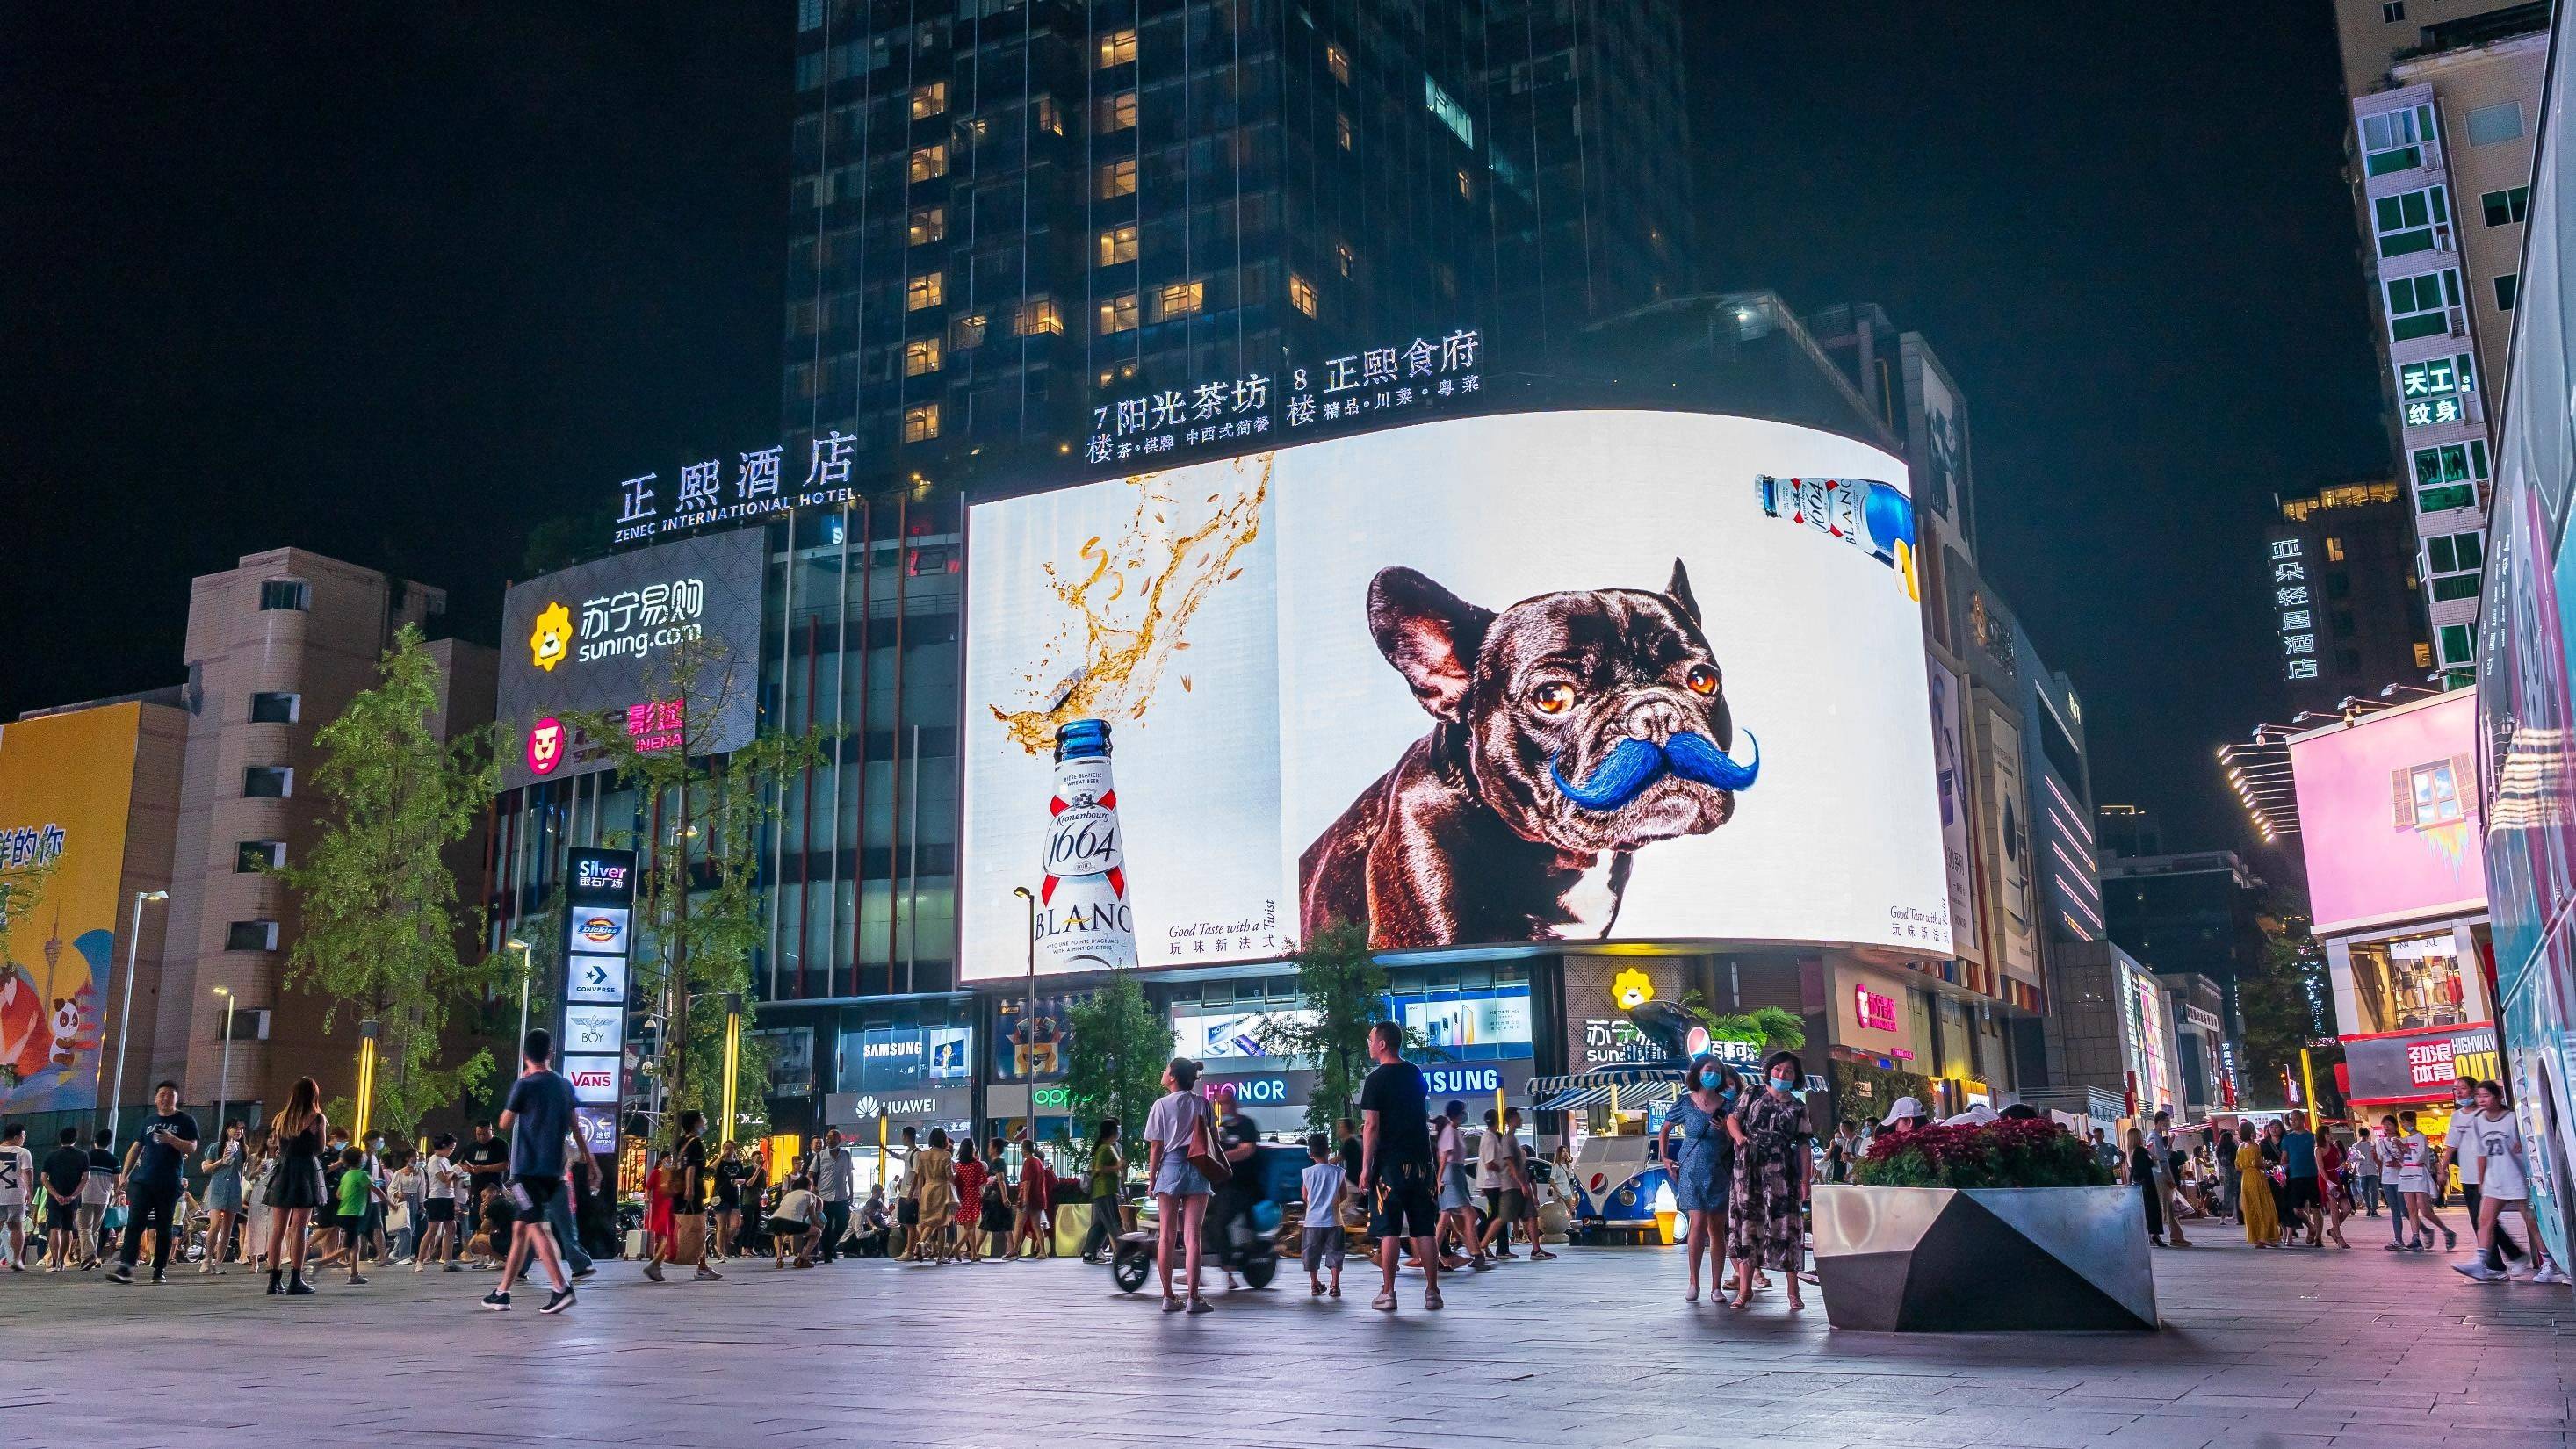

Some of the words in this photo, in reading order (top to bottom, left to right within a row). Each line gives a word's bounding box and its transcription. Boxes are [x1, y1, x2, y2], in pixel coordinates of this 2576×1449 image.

[1324, 329, 1478, 393] 正熙食府
[2404, 368, 2454, 395] 天工
[1116, 376, 1270, 436] 阳光茶坊
[2408, 400, 2457, 425] 纹身
[616, 430, 858, 523] 正熙酒店
[614, 522, 656, 544] ZENEC
[661, 496, 790, 532] INTERNATIONAL
[799, 487, 855, 507] HOTEL
[1805, 480, 1827, 530] 1664
[1839, 479, 1857, 546] BLANC
[580, 578, 703, 639] 苏宁易购
[1057, 811, 1109, 826] Kronenbourg
[1048, 820, 1118, 867] 1664
[579, 861, 627, 878] Silver
[1035, 902, 1131, 941] BLANC
[1263, 899, 1274, 930] Twist
[1890, 905, 1909, 919] Good
[1909, 908, 1924, 922] Taste
[1925, 912, 1937, 925] with
[582, 926, 618, 934] Dickies
[1169, 924, 1195, 938] Good
[1200, 923, 1224, 935] Taste
[1227, 919, 1251, 933] with
[1252, 922, 1259, 932] a
[1169, 934, 1275, 955] 玩味新法式
[582, 1033, 604, 1042] BOY
[863, 1042, 922, 1057] SAMSUNG
[2407, 1042, 2453, 1065] 劲浪
[571, 1072, 611, 1087] VANS
[2412, 1062, 2456, 1084] 体育
[1206, 1080, 1285, 1101] HONOR
[882, 1099, 936, 1114] HUAWEI
